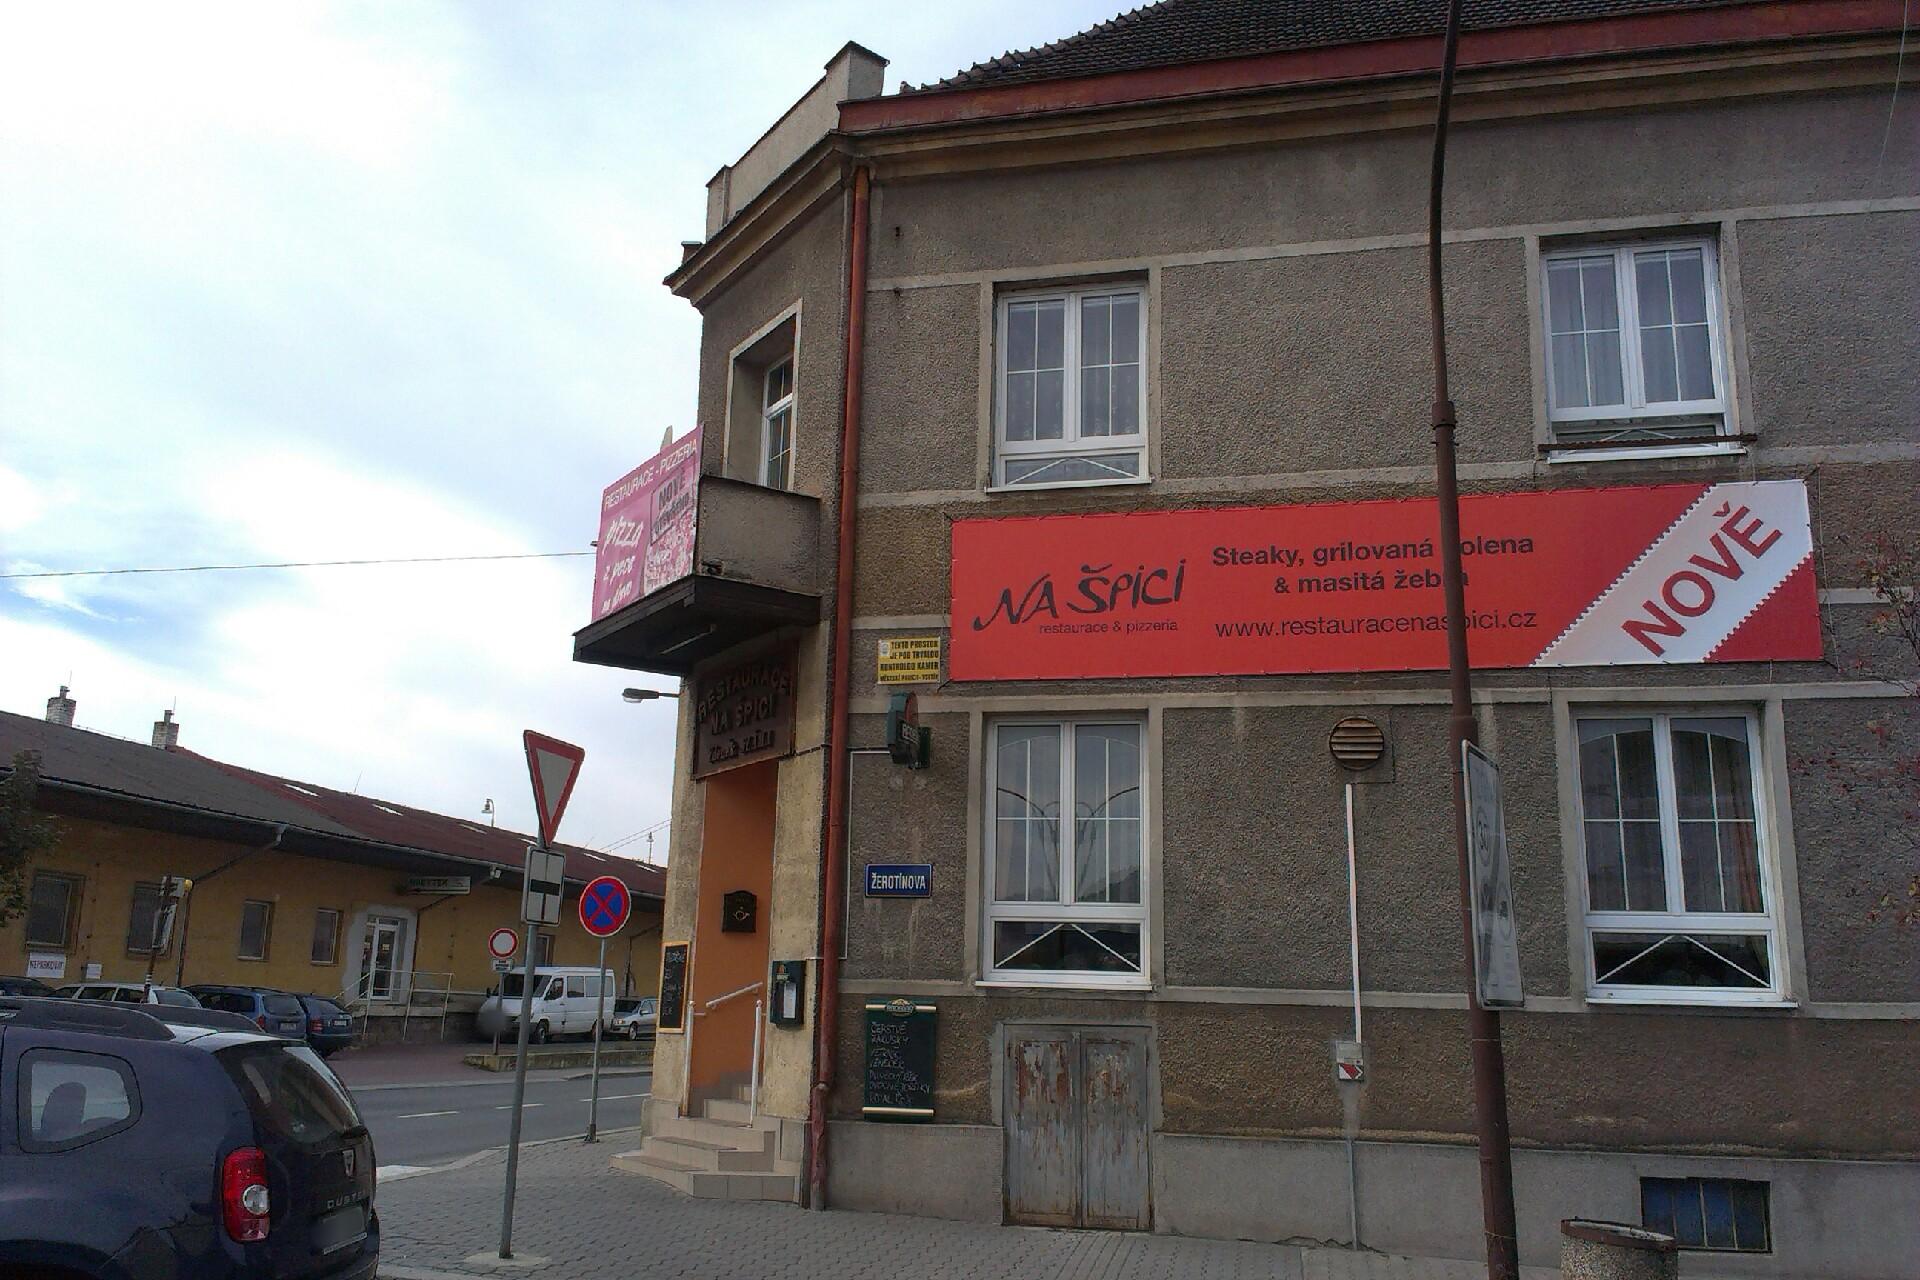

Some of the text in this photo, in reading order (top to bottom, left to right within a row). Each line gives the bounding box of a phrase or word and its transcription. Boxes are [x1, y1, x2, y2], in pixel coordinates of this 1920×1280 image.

[604, 465, 654, 512] RESTAURACE
[660, 438, 697, 476] PIZZERIA
[1213, 536, 1534, 568] Steaky, grilovaná olena
[1274, 577, 1290, 594] &
[1298, 571, 1385, 593] masitá
[1620, 500, 1783, 658] NOVĚ
[973, 573, 1059, 631] NA
[1039, 619, 1178, 635] restaurace & pizzeria
[871, 872, 926, 890] ŽEROTÍNOVA
